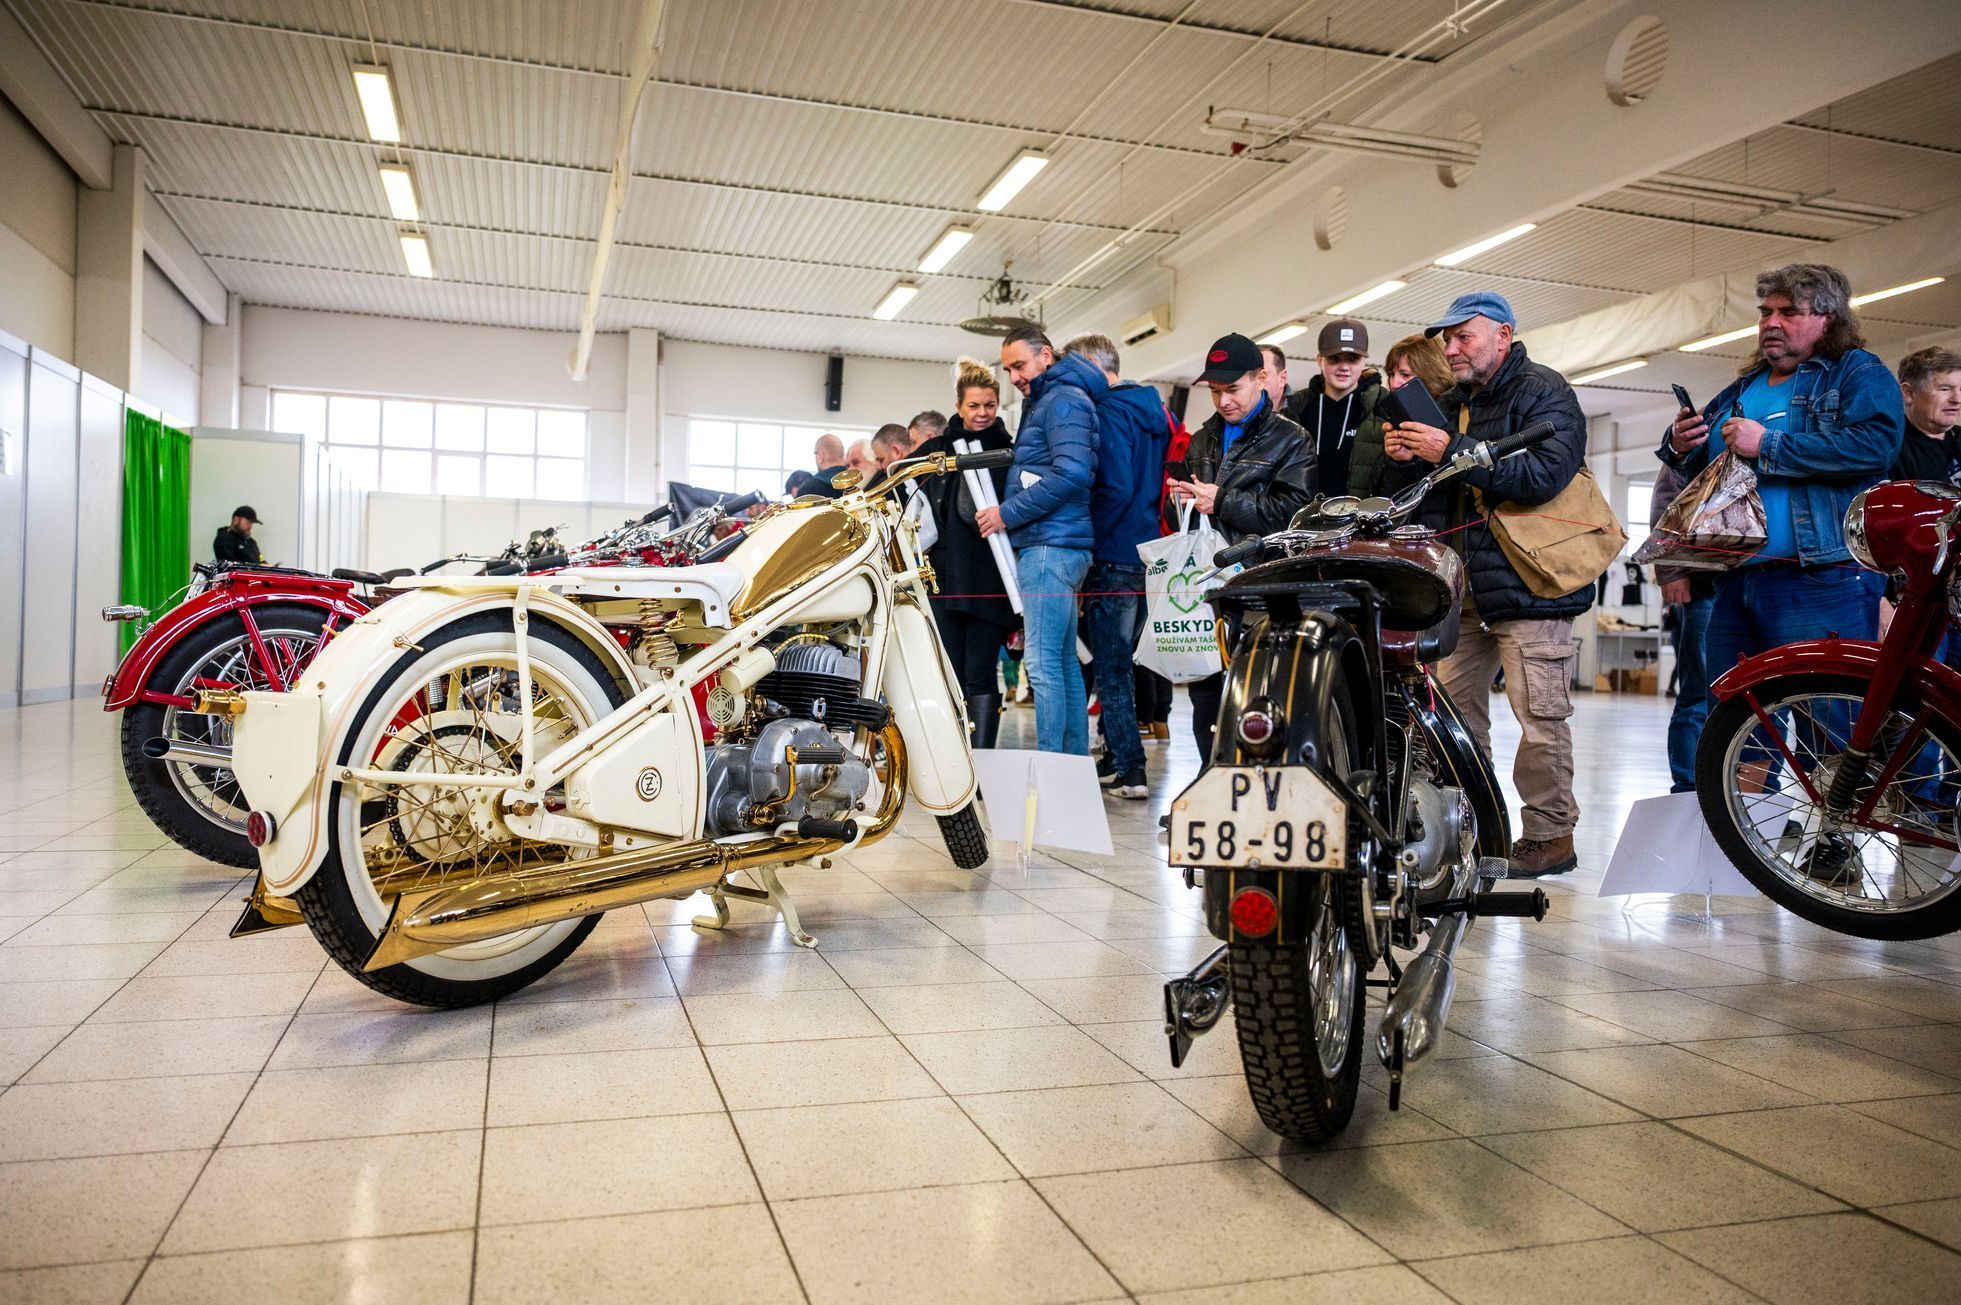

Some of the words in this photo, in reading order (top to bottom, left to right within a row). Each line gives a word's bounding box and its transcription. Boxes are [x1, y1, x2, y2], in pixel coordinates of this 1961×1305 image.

[1154, 620, 1214, 633] BESKYD
[1155, 635, 1197, 644] POUŽÍVÁM
[1156, 645, 1185, 653] ZNOVU
[1187, 820, 1326, 862] 58-98
